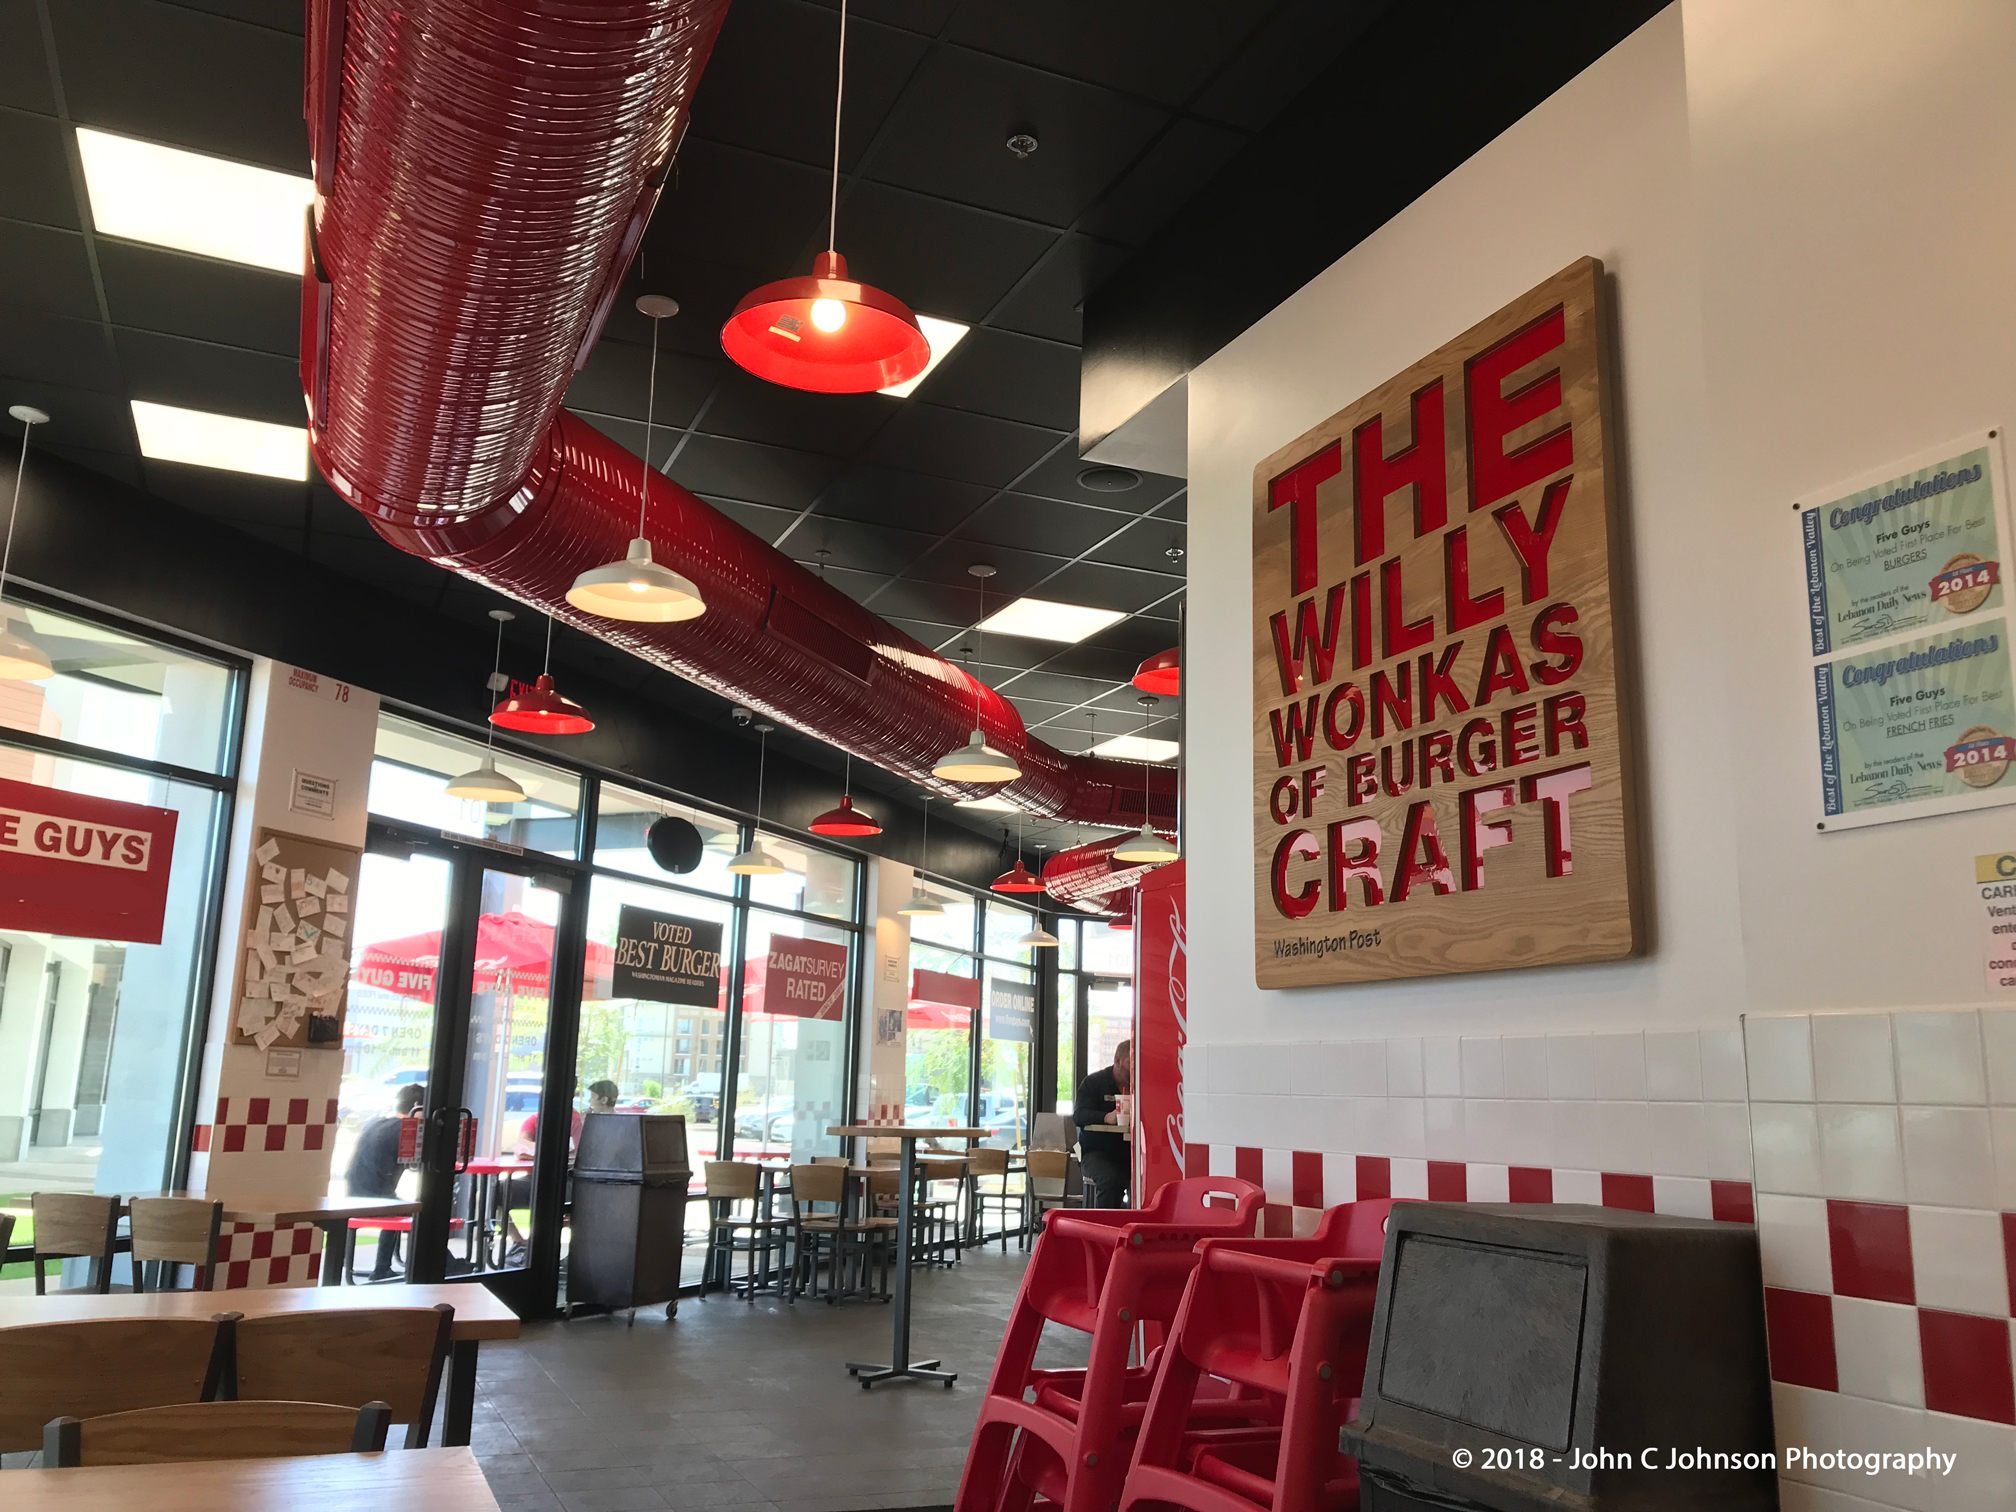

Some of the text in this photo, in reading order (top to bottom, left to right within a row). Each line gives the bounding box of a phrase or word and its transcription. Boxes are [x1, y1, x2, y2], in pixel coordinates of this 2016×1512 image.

[1267, 302, 1575, 598] THE
[1829, 464, 1983, 530] Congratulations
[1831, 517, 1986, 573] On Being Voted First Place For Best
[1876, 520, 1931, 544] Five Guys
[1883, 549, 1928, 571] BURGERS
[1269, 474, 1575, 698] WILLY
[1805, 512, 1825, 653] Best of the Lebanon Valley
[1938, 569, 1990, 596] 2014
[1838, 605, 1875, 623] Lebanon
[1877, 597, 1899, 611] Daily
[1842, 634, 1998, 688] Congratulations
[288, 677, 319, 693] OCCUPANCY
[335, 683, 350, 703] 78
[1269, 603, 1585, 768] WONKAS
[1890, 687, 1945, 707] Five Guys
[1843, 721, 1857, 732] On
[1859, 716, 1884, 728] Being
[1887, 708, 1912, 722] Voted
[1935, 699, 1961, 711] Place
[1964, 693, 1978, 705] For
[1886, 714, 1955, 738] FRENCH FRIES
[1817, 667, 1837, 813] Best of the Lebanon Valley
[1270, 691, 1589, 825] OF BURGER
[1954, 745, 2007, 767] 2014
[1850, 769, 1888, 784] Lebanon
[1891, 763, 1913, 776] Daily
[34, 821, 145, 865] GUYS
[1271, 762, 1592, 919] CRAFT
[1981, 885, 2016, 900] CAR
[653, 921, 692, 944] VOTED
[1274, 929, 1381, 958] Washington Post
[616, 937, 721, 978] BEST BURGER
[769, 951, 845, 979] ZAGATSURVEY
[786, 977, 826, 1002] RATED
[991, 990, 1035, 1013] ORDER ONLINE
